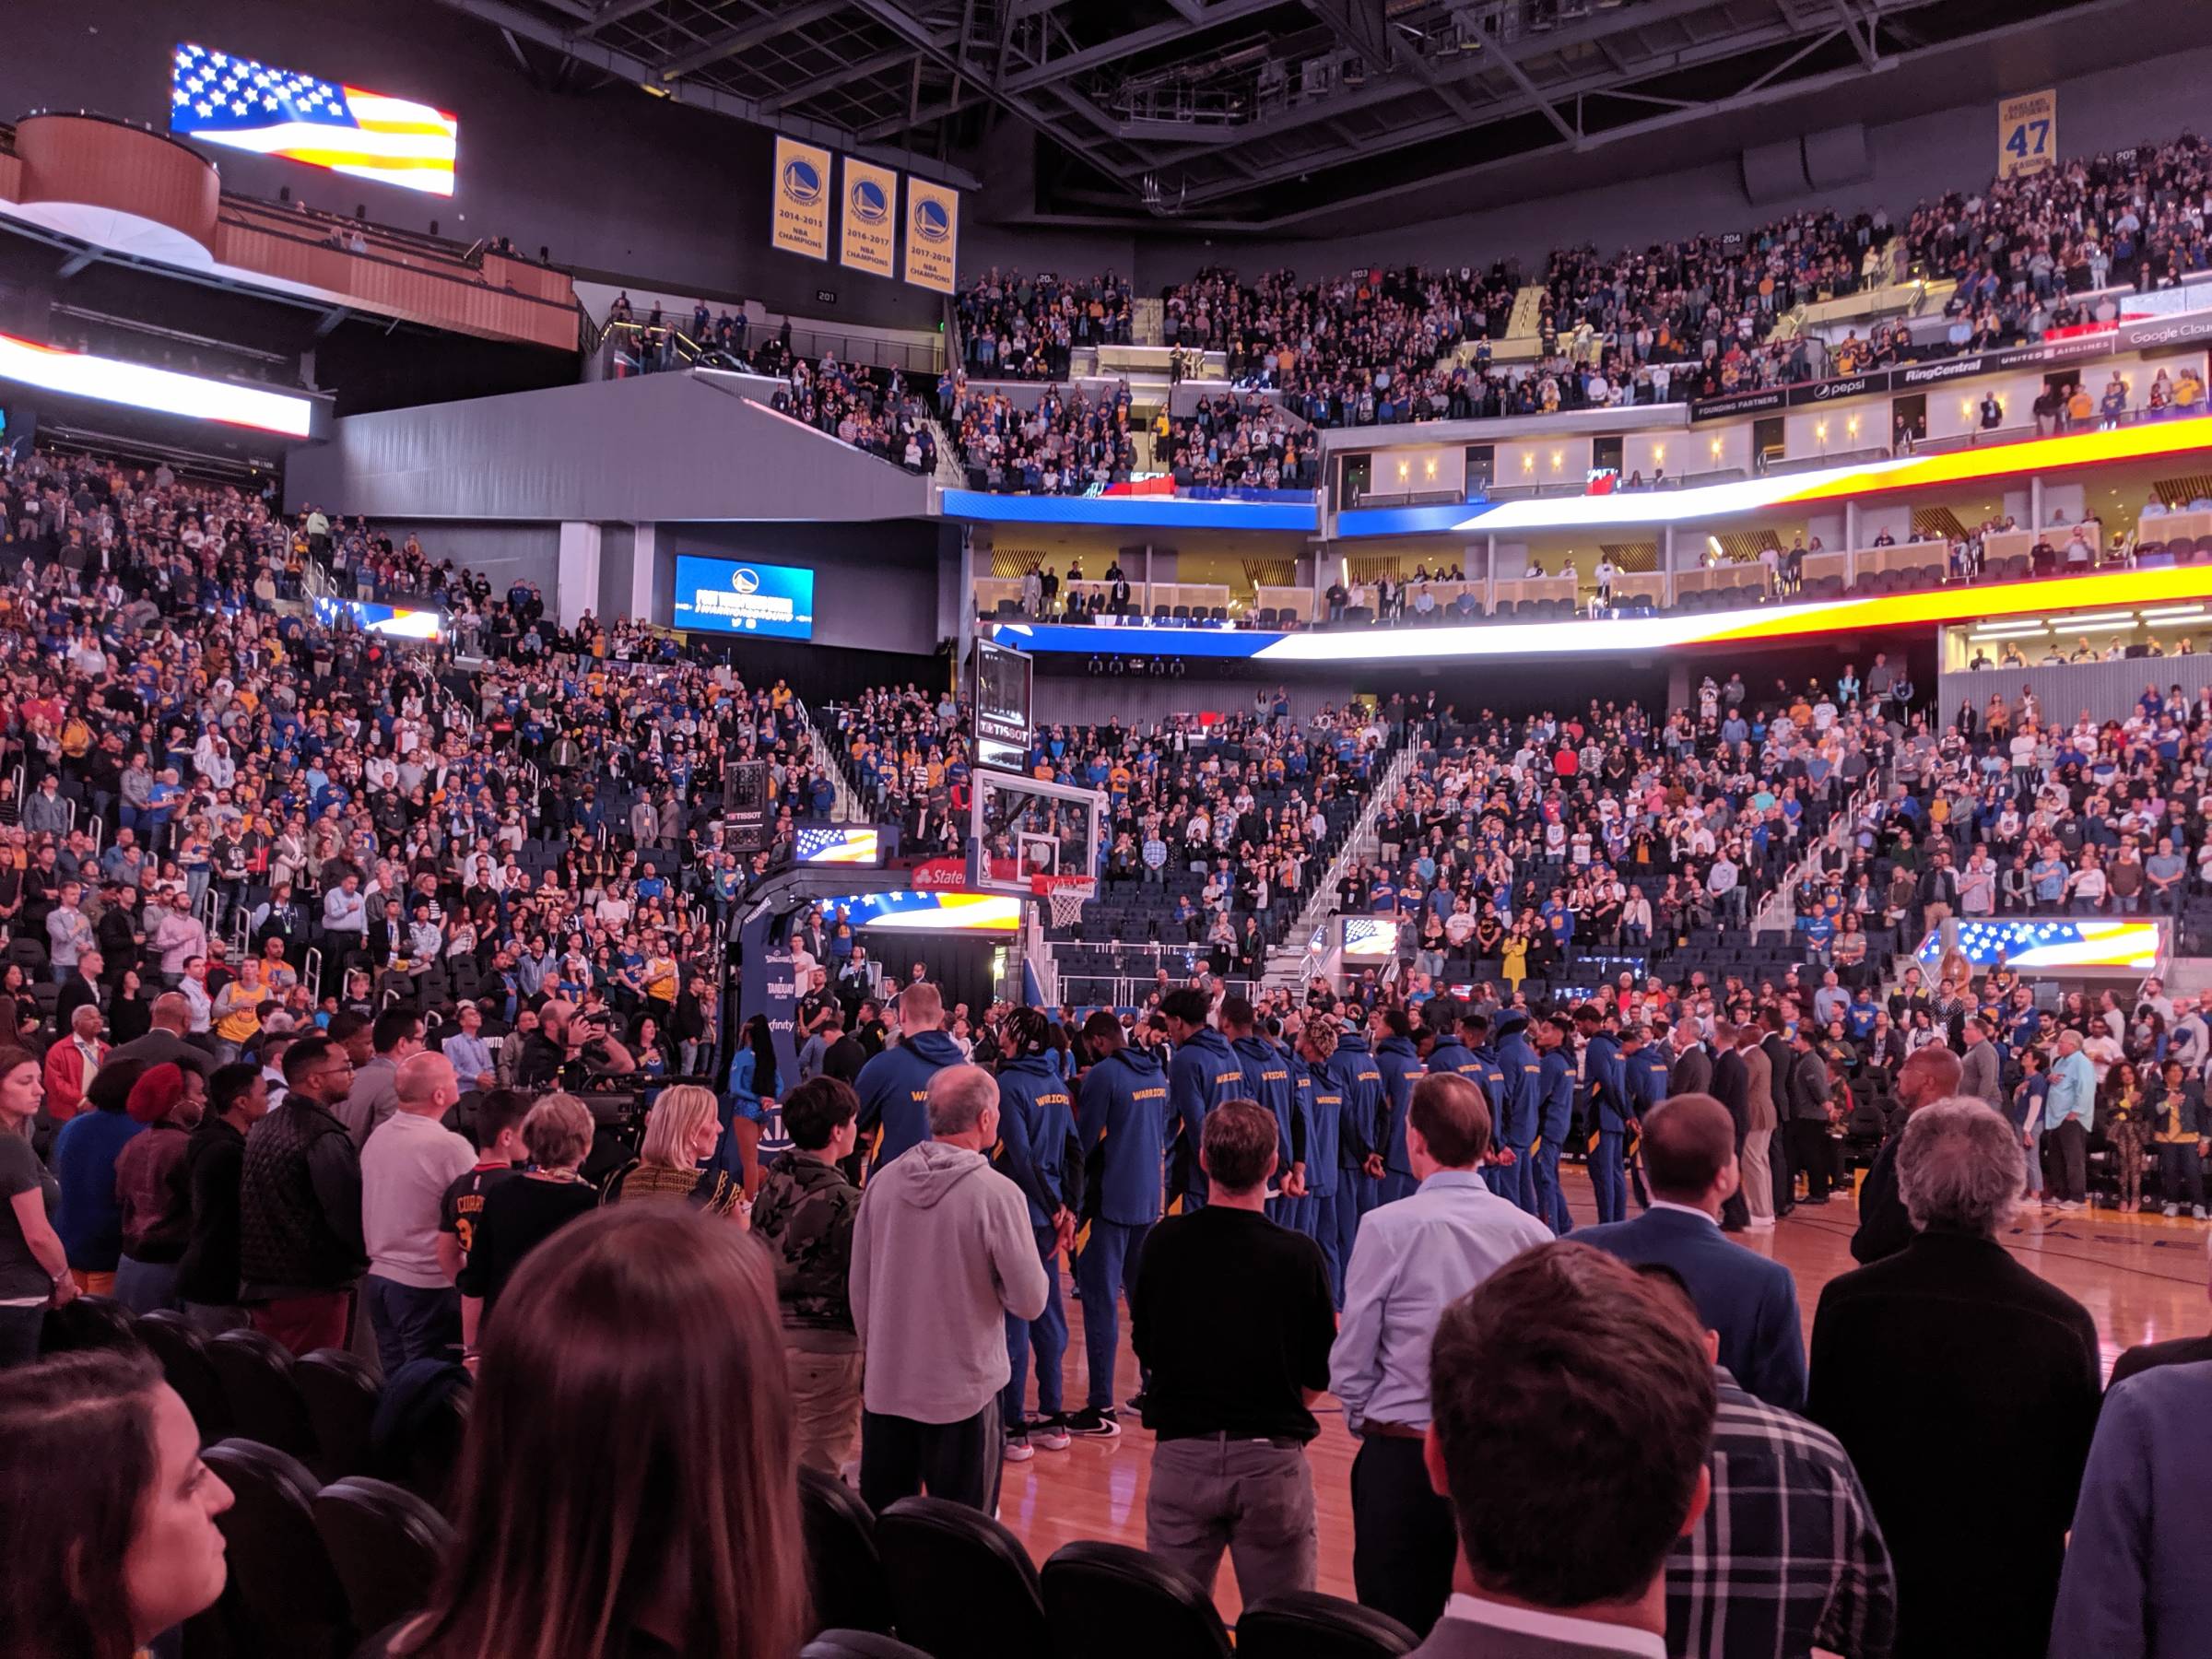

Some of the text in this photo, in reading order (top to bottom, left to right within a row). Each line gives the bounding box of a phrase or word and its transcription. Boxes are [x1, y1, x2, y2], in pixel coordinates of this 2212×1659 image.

[2006, 119, 2051, 158] 47
[779, 209, 823, 228] 2014-2015
[778, 230, 822, 249] CHAMPIONS
[793, 227, 808, 237] NBA
[847, 228, 888, 246] 2016-2017
[1724, 233, 1741, 243] 204
[846, 250, 888, 266] CHAMPIONS
[860, 245, 875, 255] NBA
[911, 246, 951, 264] 2017-2018
[910, 267, 950, 284] CHAMPIONS
[923, 263, 937, 273] NBA
[818, 291, 834, 302] 201
[2130, 323, 2212, 345] Google Clou
[2001, 341, 2110, 365] UNITED AIRLINES
[1905, 359, 1982, 382] RingCentral
[1831, 379, 1865, 396] pepsi
[1699, 395, 1779, 416] FOUNDING PARTNERS
[994, 724, 1029, 743] TISSOT
[736, 811, 762, 820] TISSOT
[767, 982, 794, 994] TANDUAY
